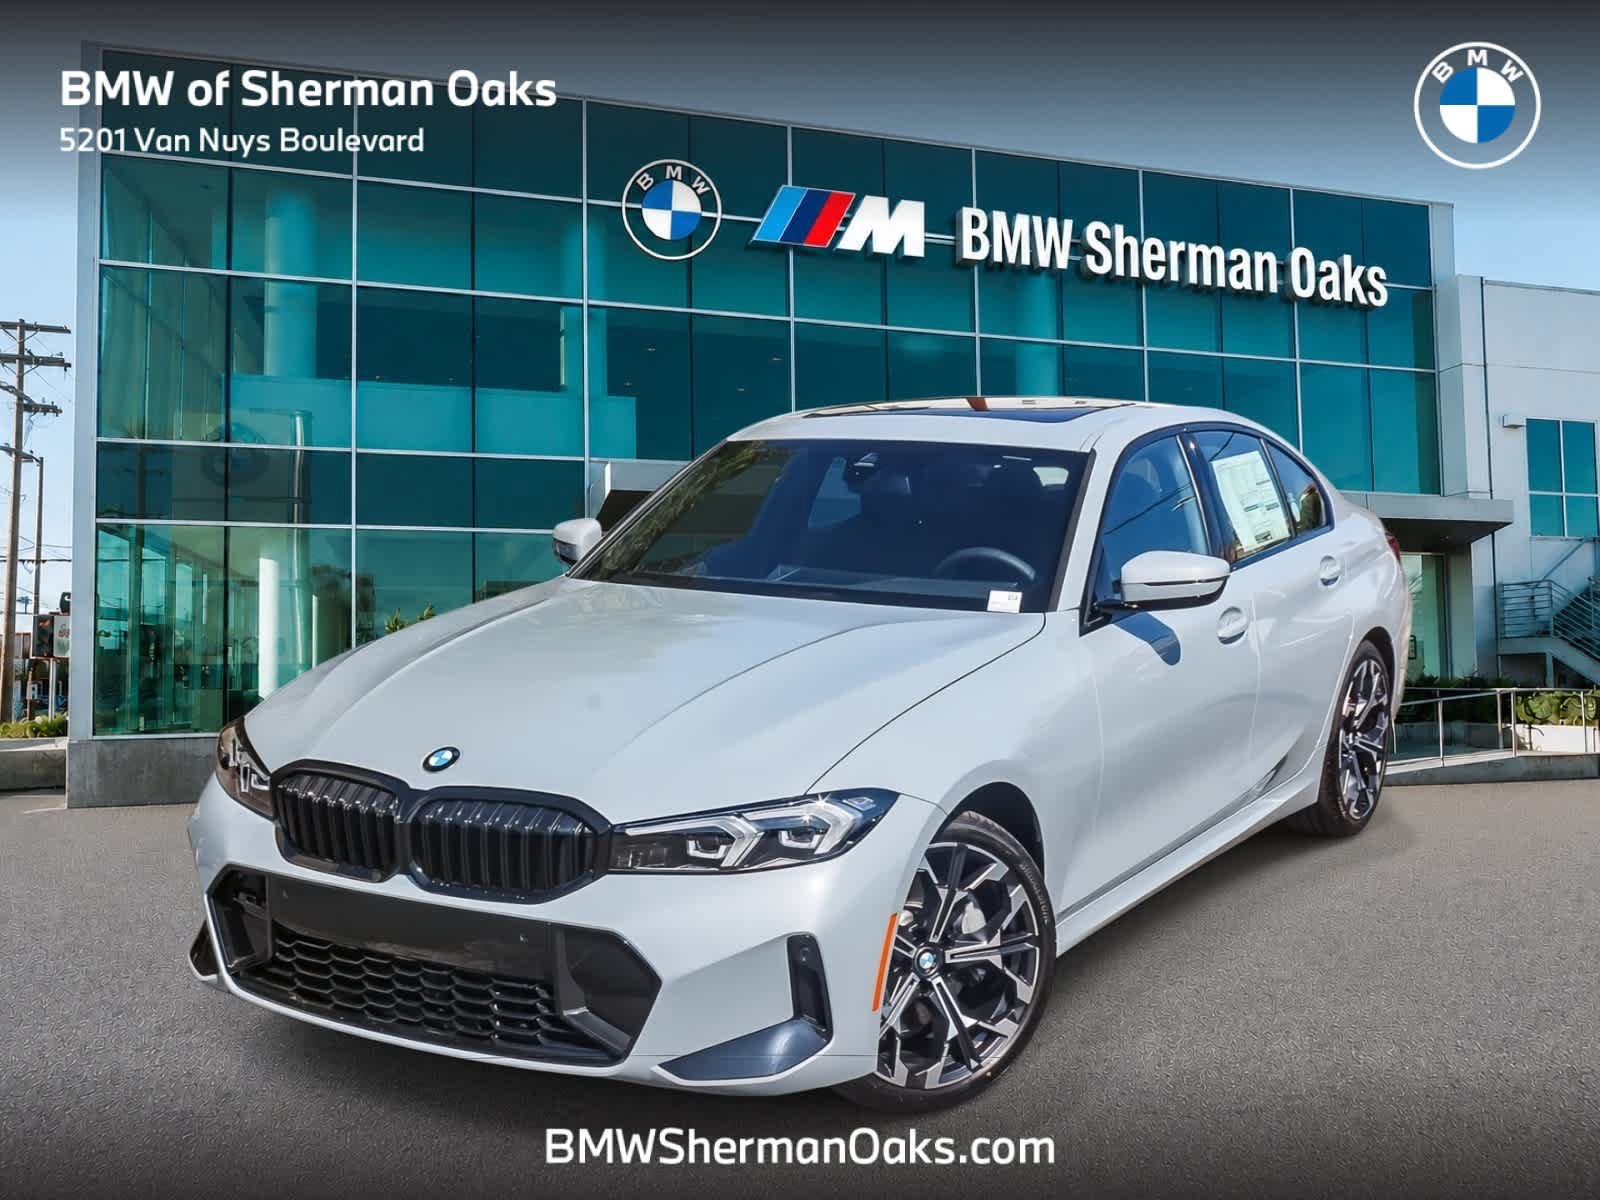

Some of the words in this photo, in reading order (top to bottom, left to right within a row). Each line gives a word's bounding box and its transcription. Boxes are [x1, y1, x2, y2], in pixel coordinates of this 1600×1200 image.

[636, 164, 711, 196] BMW
[960, 206, 1073, 270] BMW
[1085, 221, 1278, 294] Sherman
[1289, 246, 1389, 308] Oaks
